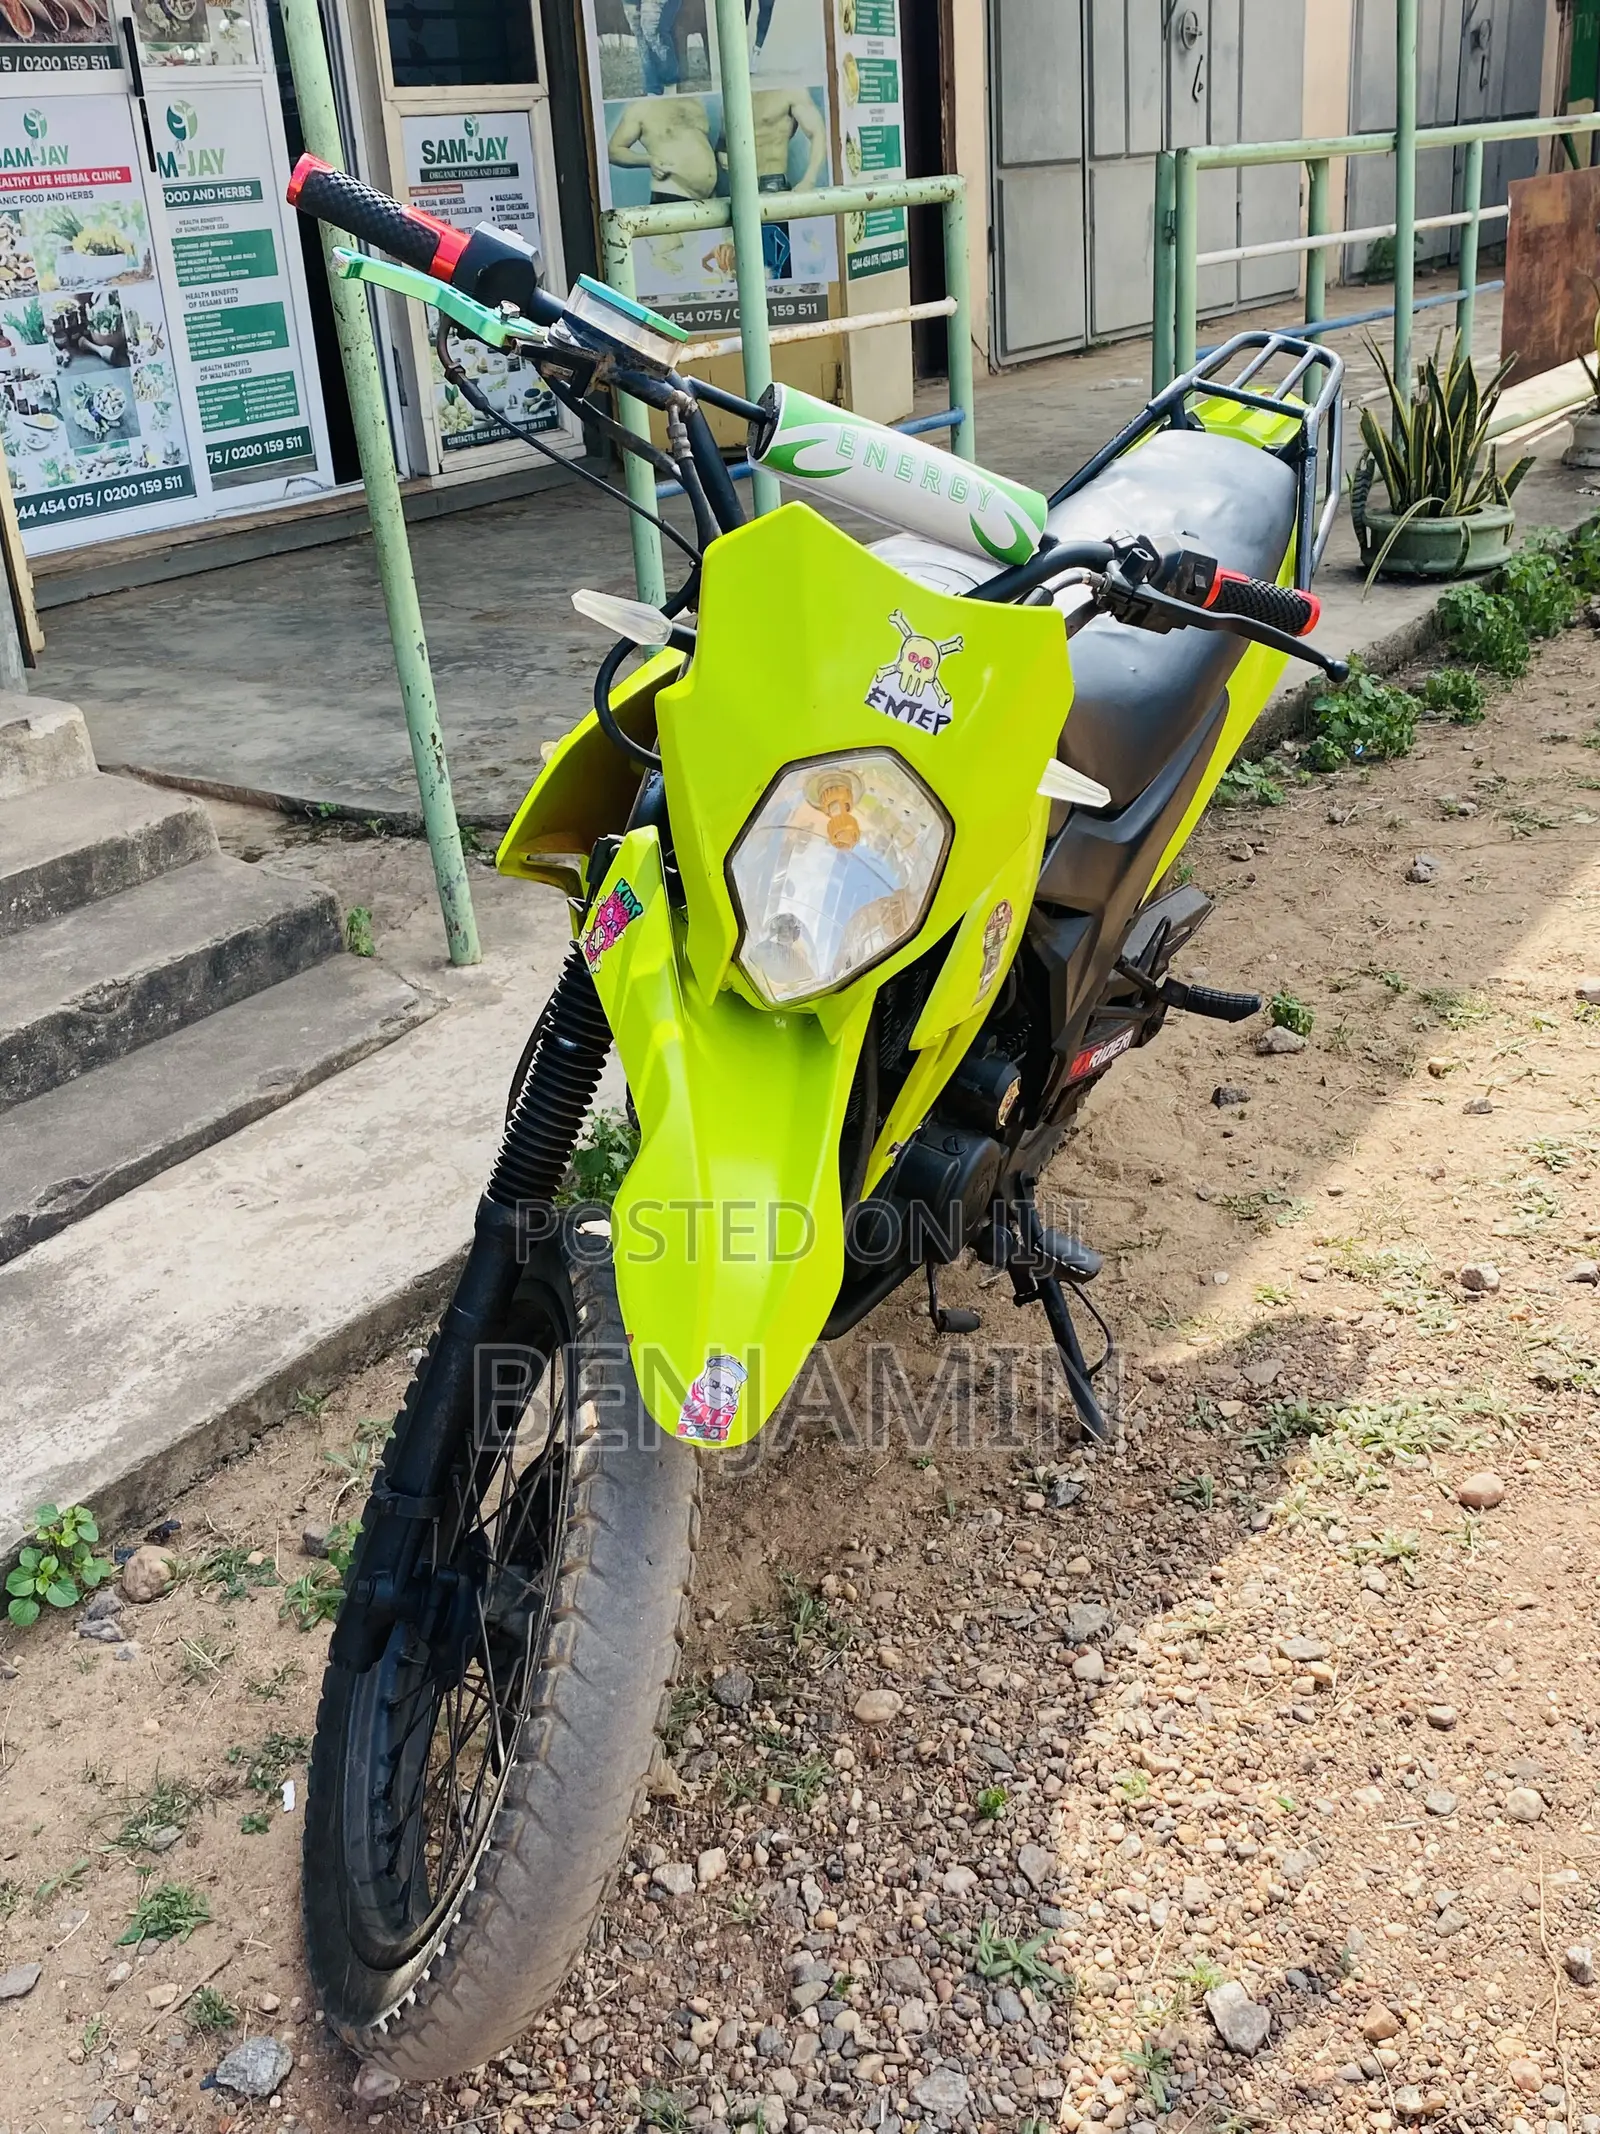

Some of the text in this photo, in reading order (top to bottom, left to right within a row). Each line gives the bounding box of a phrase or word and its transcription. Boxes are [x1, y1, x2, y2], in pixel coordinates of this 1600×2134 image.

[23, 55, 61, 71] 0200
[63, 55, 88, 70] 159
[90, 54, 111, 69] 511
[0, 145, 69, 168] AM-JAY
[421, 136, 509, 165] SAM-JAY
[0, 170, 121, 188] ALTHY LIFE HERBAL CLINIC
[479, 168, 492, 176] AND
[19, 194, 44, 204] FOOD
[47, 193, 65, 202] AND
[66, 190, 94, 200] HERBS
[164, 185, 252, 203] OOD AND HERBS
[186, 287, 239, 300] HEALTH BENEFITS
[199, 300, 222, 308] SESAME
[772, 303, 818, 317] 159 511
[697, 309, 722, 322] 075
[200, 364, 222, 373] HEALTH
[210, 371, 237, 380] WALNUTS
[231, 443, 262, 460] 0200
[263, 439, 284, 454] 159
[286, 435, 303, 449] 511
[835, 425, 997, 512] ENERGY
[39, 498, 66, 515] 454
[67, 492, 94, 510] 075
[96, 490, 101, 507] /
[103, 483, 138, 501] 0200
[140, 479, 162, 495] 159
[164, 475, 183, 490] 511
